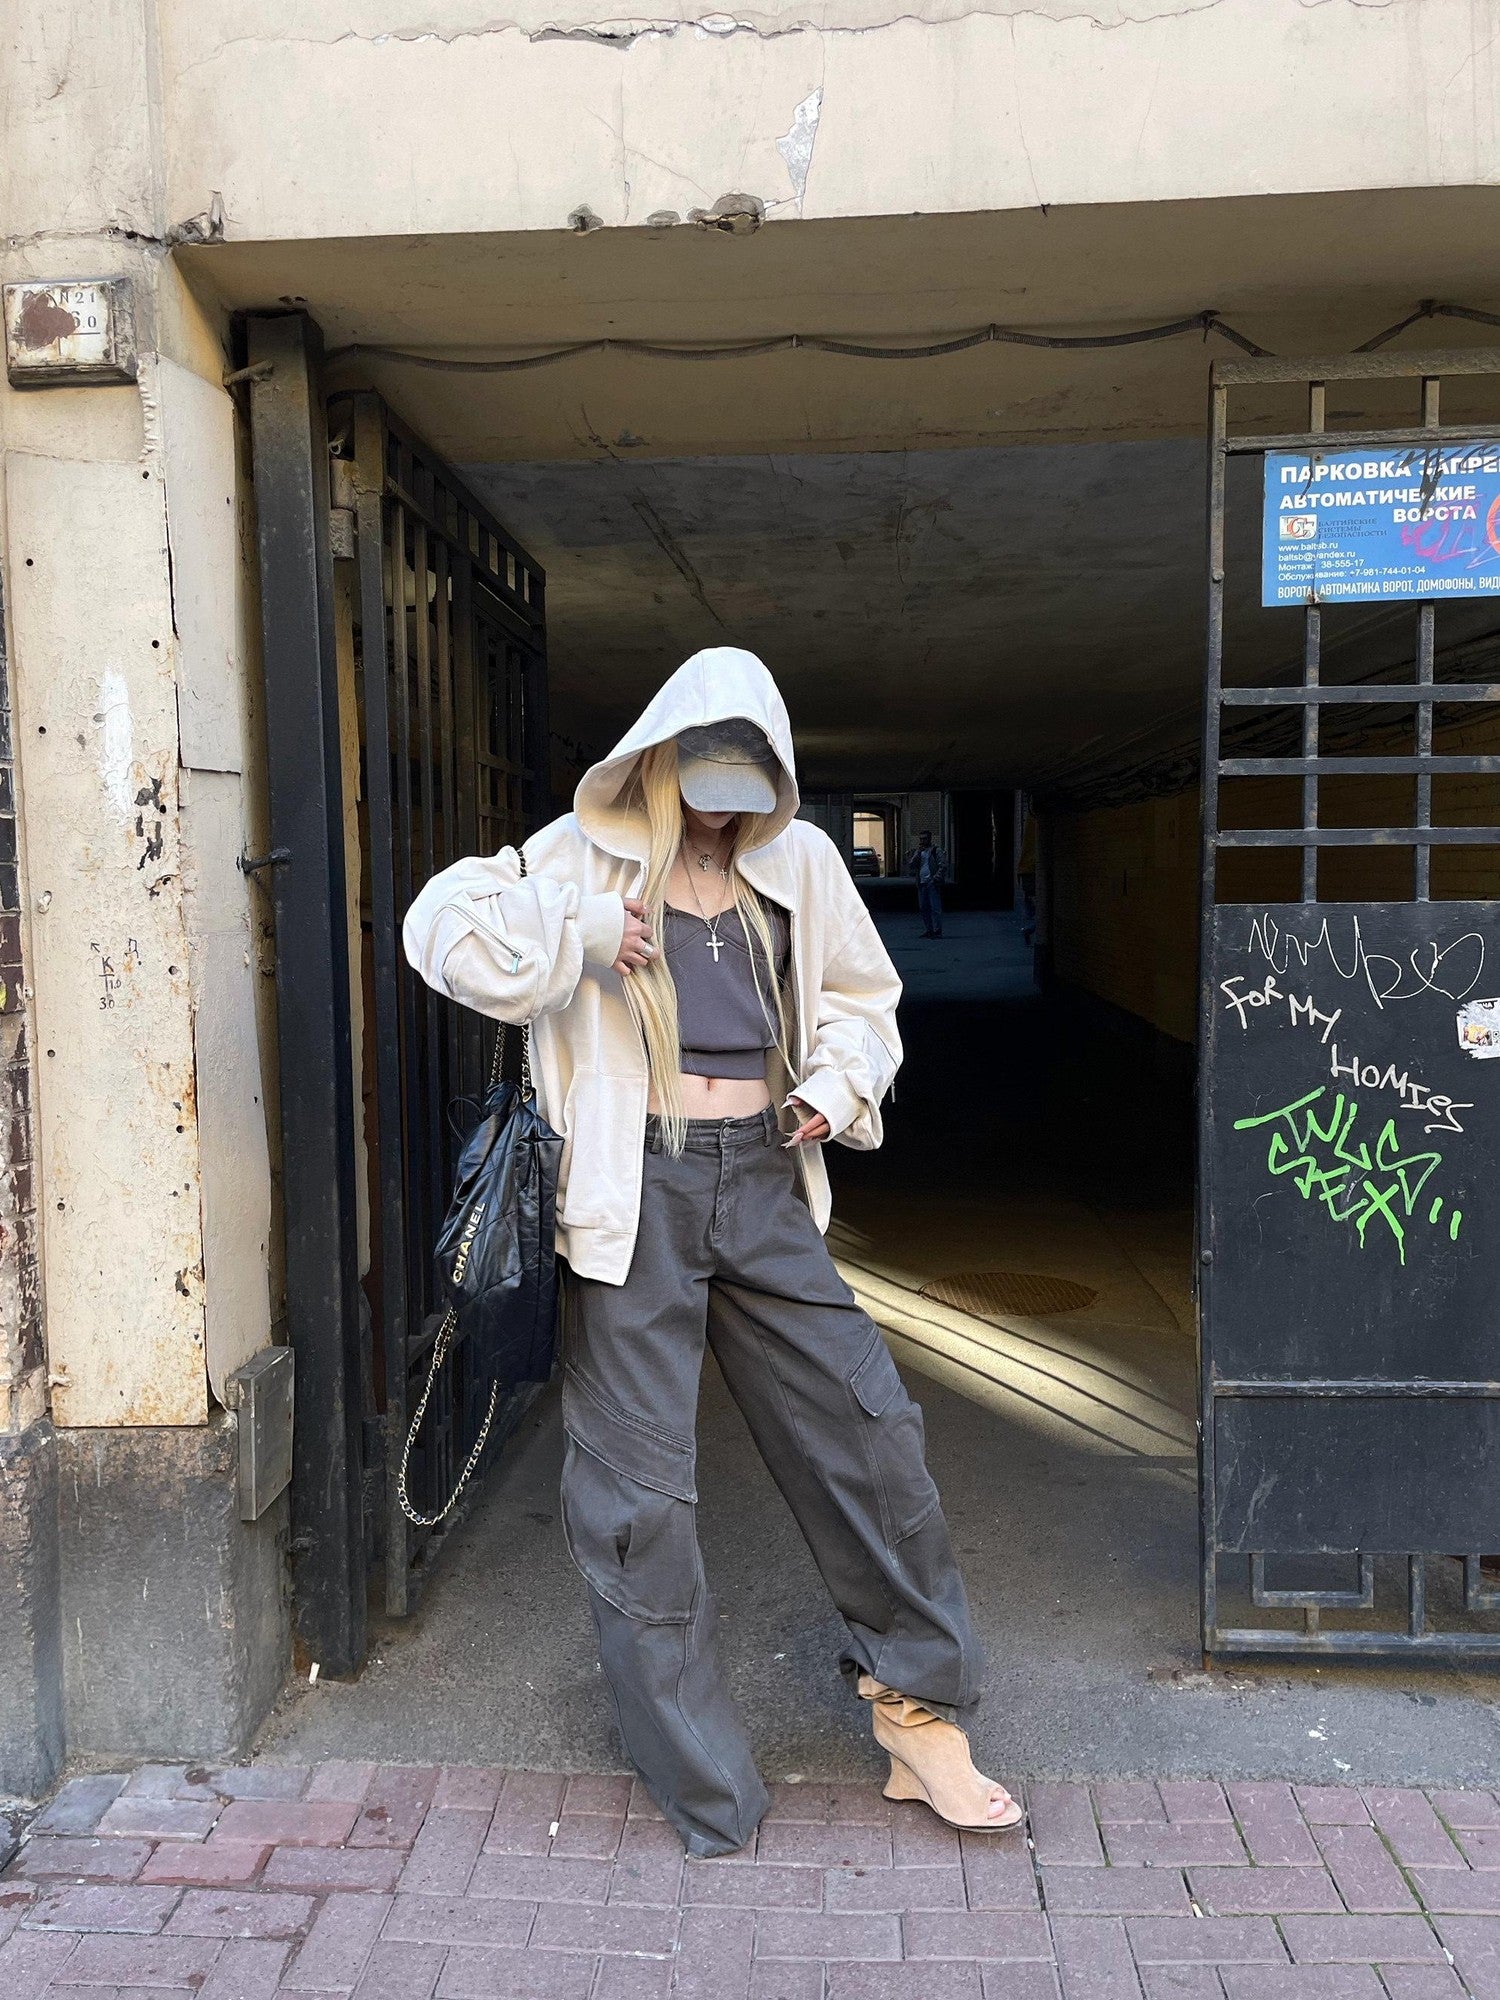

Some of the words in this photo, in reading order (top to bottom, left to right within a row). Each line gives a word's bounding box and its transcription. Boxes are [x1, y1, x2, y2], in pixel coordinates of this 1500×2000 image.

[1280, 461, 1412, 484] ПАРКОВКА
[1418, 455, 1500, 476] ЗАПРЕ
[1320, 581, 1380, 596] АВТОМАТИКА
[1383, 580, 1414, 593] ВОРОТ,
[1416, 577, 1476, 593] ДОМОФОНЫ,
[1479, 576, 1500, 590] ВИД
[452, 1202, 486, 1283] CHANEL
